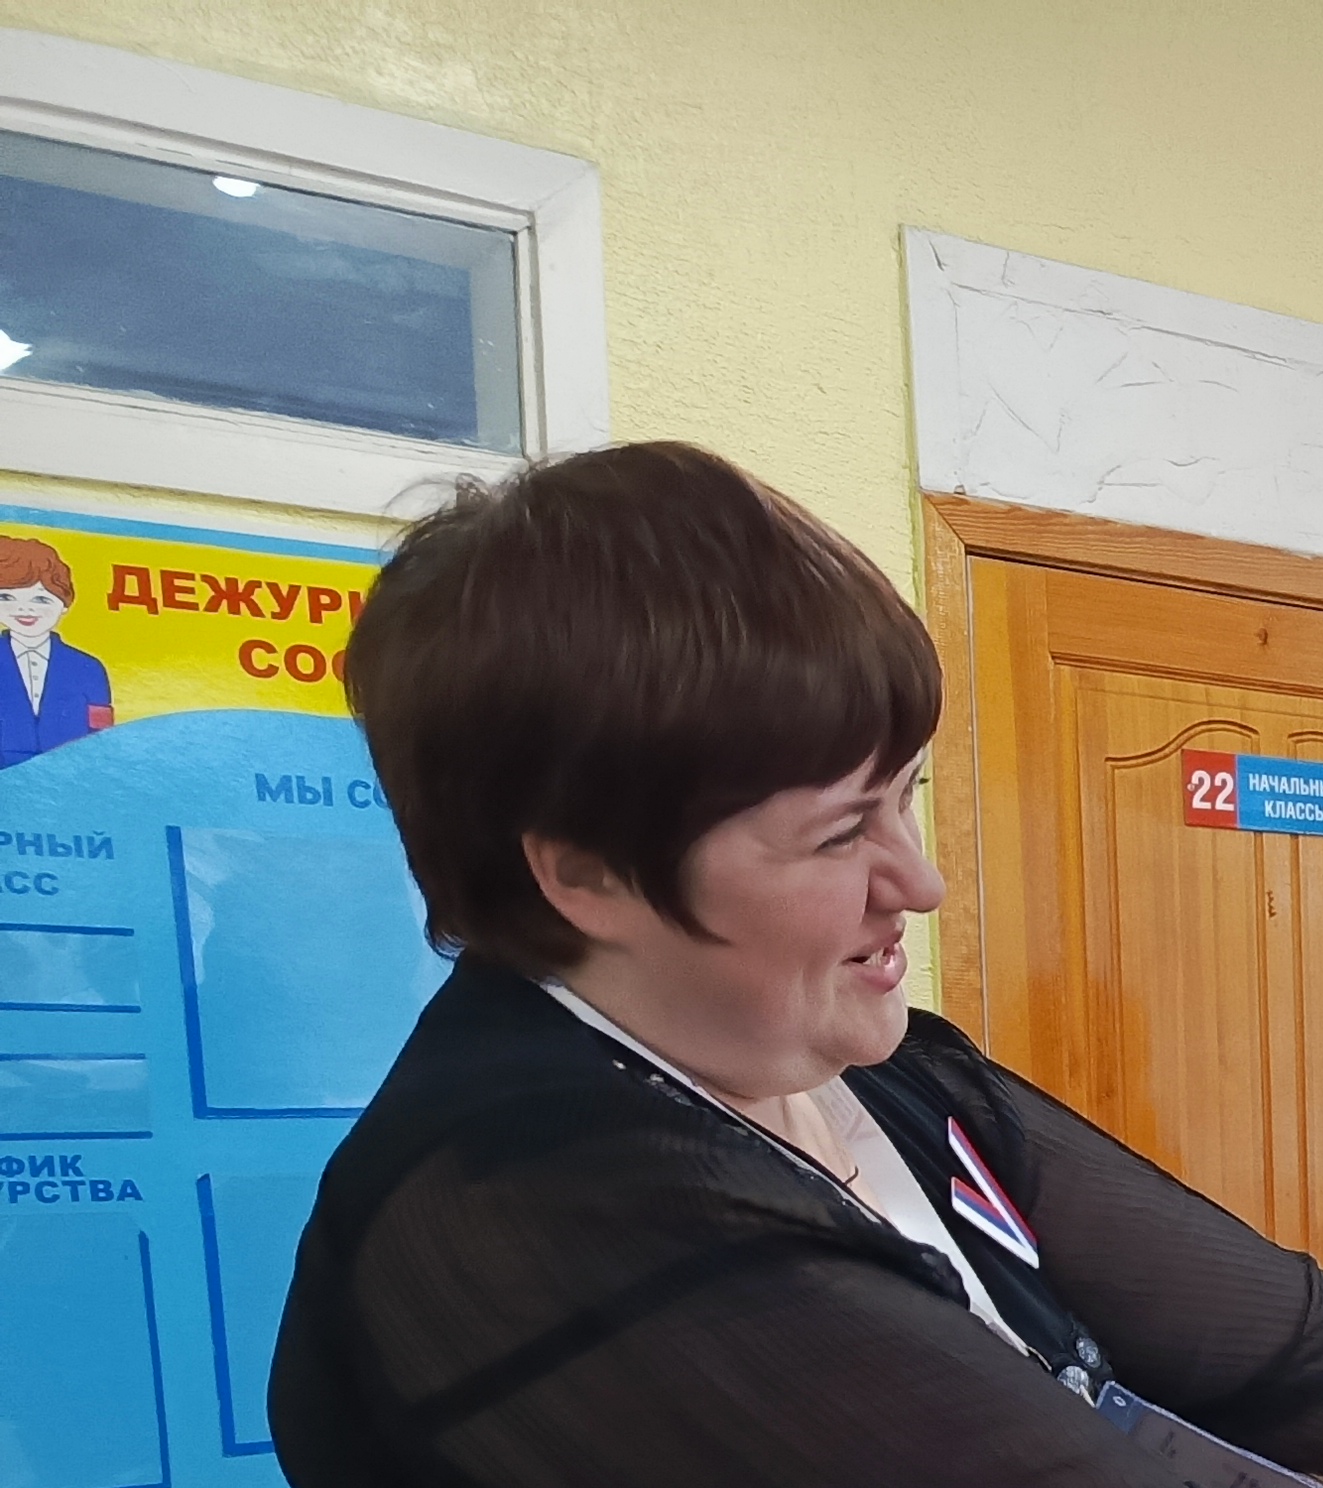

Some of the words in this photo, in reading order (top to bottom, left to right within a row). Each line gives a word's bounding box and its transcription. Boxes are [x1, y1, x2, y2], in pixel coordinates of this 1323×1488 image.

[254, 773, 334, 807] МЫ
[1191, 770, 1235, 811] 22
[0, 870, 60, 896] СС
[0, 1179, 144, 1204] РСТВА
